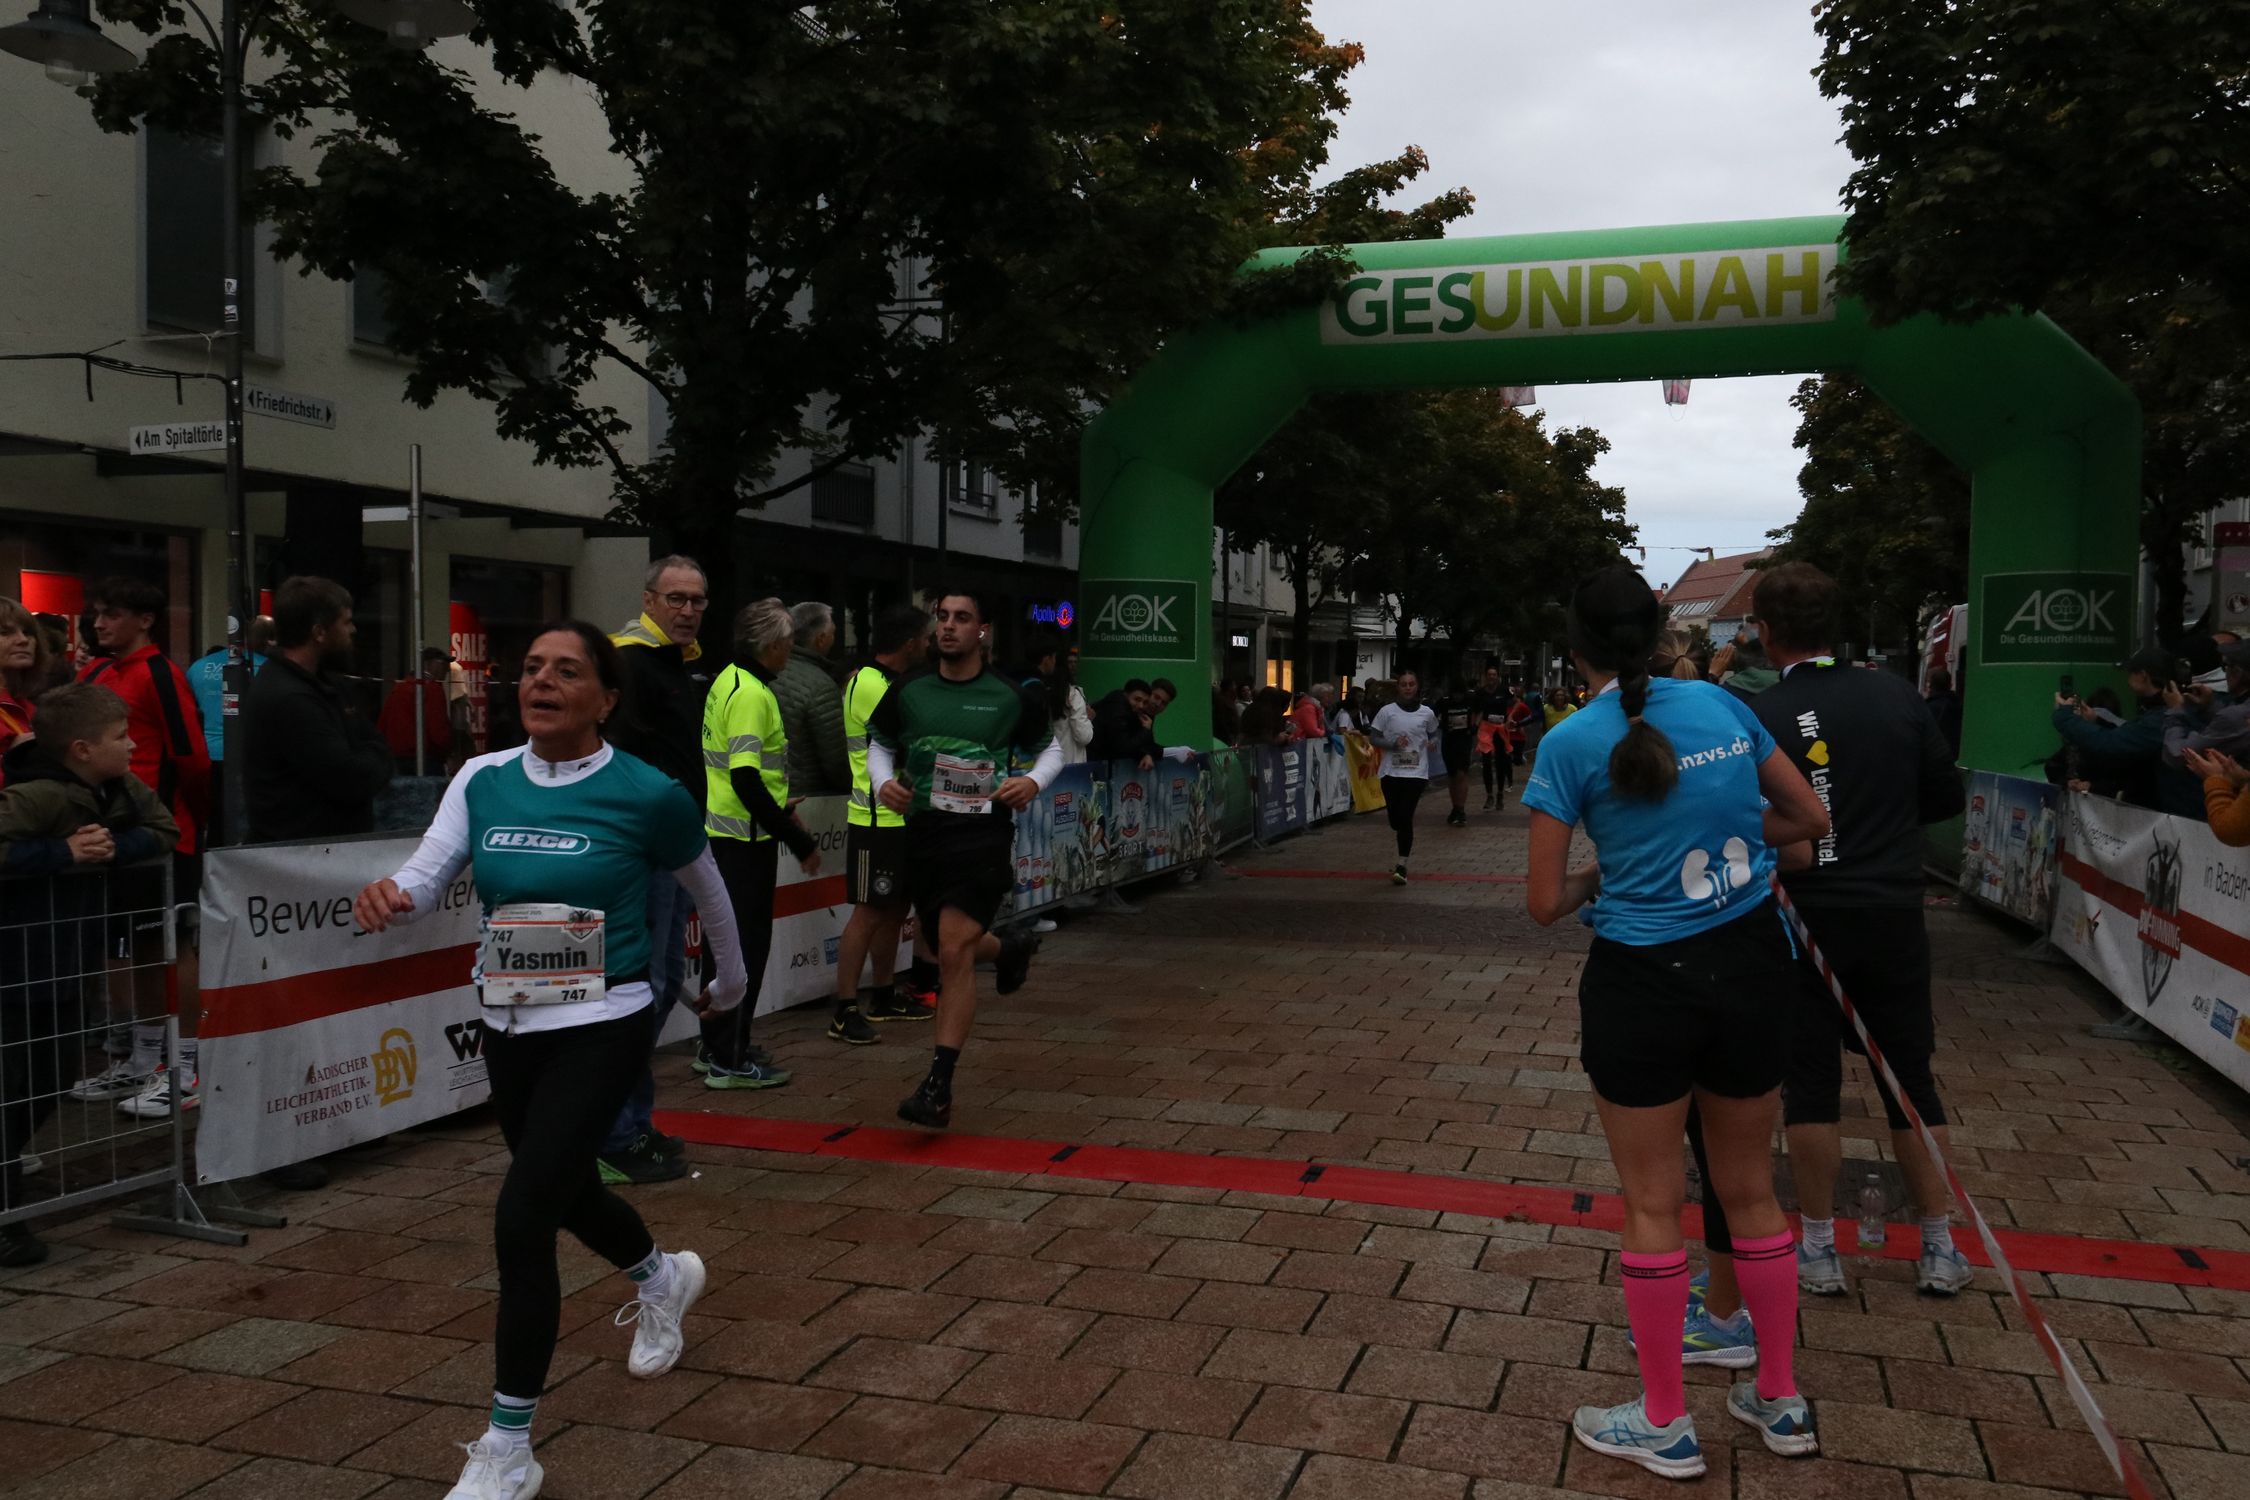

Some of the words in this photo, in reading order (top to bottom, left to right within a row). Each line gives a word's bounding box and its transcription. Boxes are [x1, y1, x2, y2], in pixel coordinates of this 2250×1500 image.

[1335, 251, 1820, 337] GESUNDNAH
[257, 391, 323, 421] Friedrichstr.
[144, 430, 160, 447] Am
[165, 426, 223, 449] Spitaltörle
[1092, 594, 1178, 632] AOK
[2003, 588, 2116, 632] AOK
[451, 632, 487, 662] SALE
[2000, 634, 2015, 644] Die
[1796, 709, 1821, 738] Wir
[1676, 736, 1751, 772] .nzvs.de
[943, 780, 981, 795] Burak
[488, 832, 580, 849] FLEXCO
[491, 930, 513, 942] 747
[497, 947, 588, 970] Yasmin
[561, 988, 587, 1001] 747
[266, 1075, 371, 1114] LEICHTATHLETIK-
[295, 1099, 353, 1127] VERBAND
